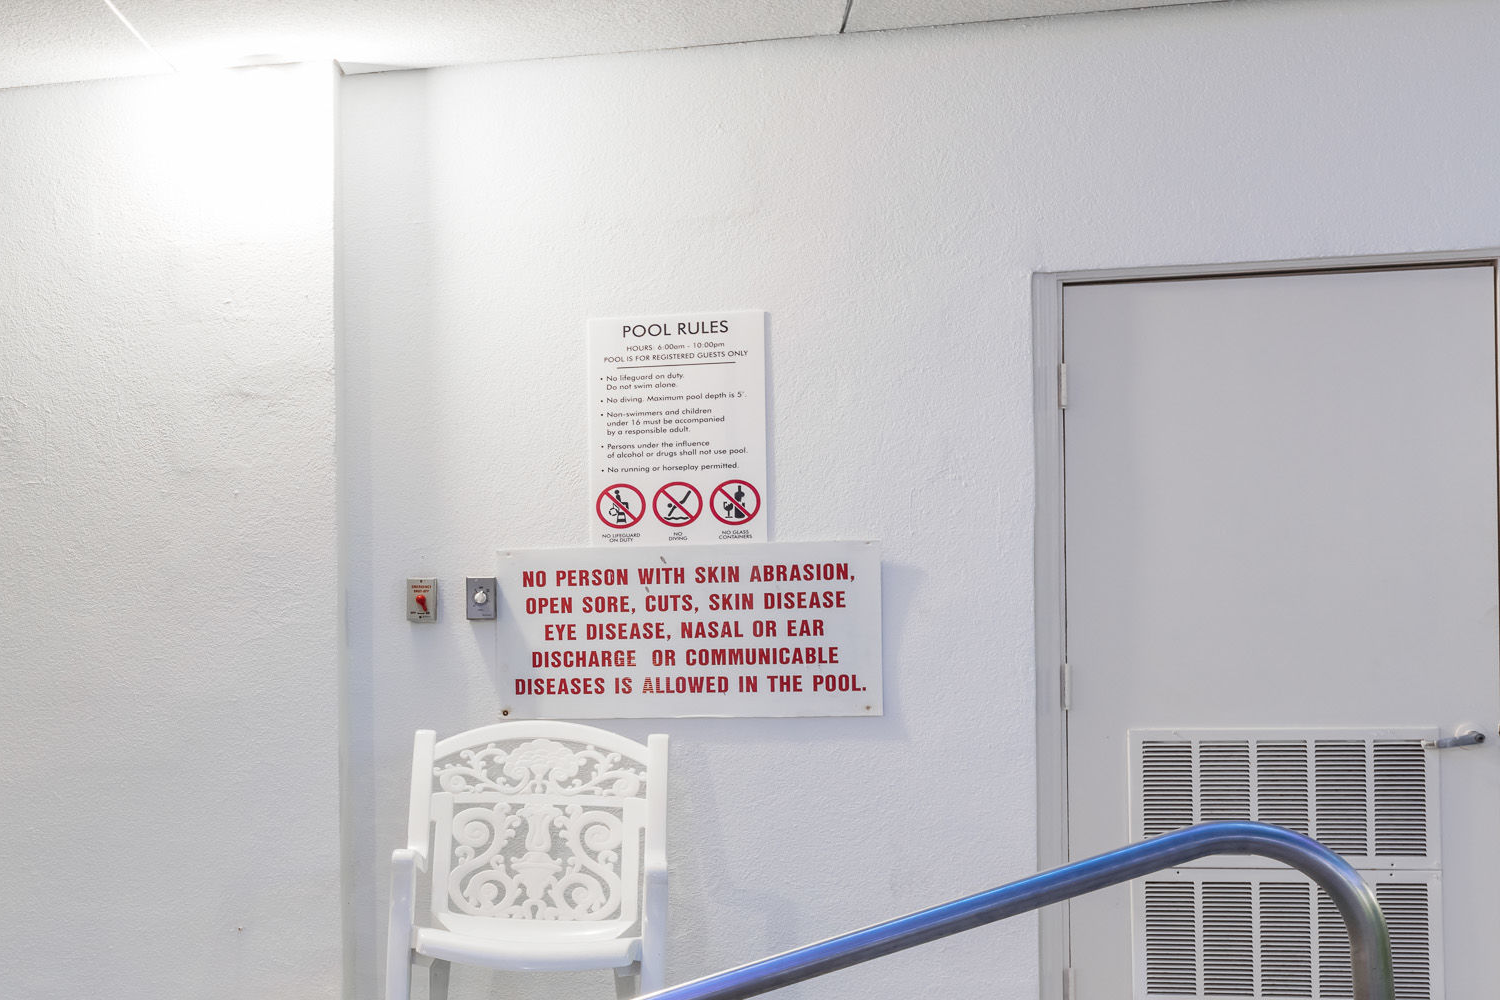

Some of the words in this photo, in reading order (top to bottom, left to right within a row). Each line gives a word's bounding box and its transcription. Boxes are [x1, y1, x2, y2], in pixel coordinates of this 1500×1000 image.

[622, 324, 671, 338] POOL
[677, 320, 729, 335] RULES
[652, 353, 695, 361] REGISTERED
[697, 351, 726, 359] GUESTS
[619, 374, 653, 382] lifeguard
[686, 393, 703, 401] pool
[704, 392, 727, 400] depth
[606, 409, 663, 418] Non-swimmers
[681, 407, 712, 415] children
[675, 416, 725, 425] accompanied
[625, 427, 667, 436] responsible
[675, 440, 710, 448] influence
[617, 451, 644, 459] alcohol
[656, 450, 677, 458] drugs
[729, 447, 748, 455] pool.
[662, 464, 699, 472] horseplay
[701, 462, 740, 471] permitted.
[522, 570, 546, 587] NO
[556, 568, 629, 587] PERSON
[638, 567, 685, 585] WITH
[695, 565, 740, 584] SKIN
[749, 562, 855, 583] ABRASION,
[525, 597, 573, 615] OPEN
[582, 596, 636, 615] SORE,
[645, 594, 699, 614] CUTS,
[708, 593, 754, 611] SKIN
[763, 591, 846, 610] DISEASE
[544, 624, 577, 641] EYE
[586, 622, 672, 642] DISEASE,
[680, 621, 744, 639] NASAL
[752, 620, 777, 638] OR
[787, 619, 825, 637] EAR
[532, 650, 637, 668] DISCHARGE
[652, 649, 676, 667] OR
[685, 646, 839, 666] COMMUNICABLE
[515, 677, 605, 696] DISEASES
[615, 677, 633, 695] IS
[642, 676, 729, 694] ALLOWED
[738, 675, 758, 693] IN
[767, 675, 803, 693] THE
[813, 674, 867, 692] POOL.
